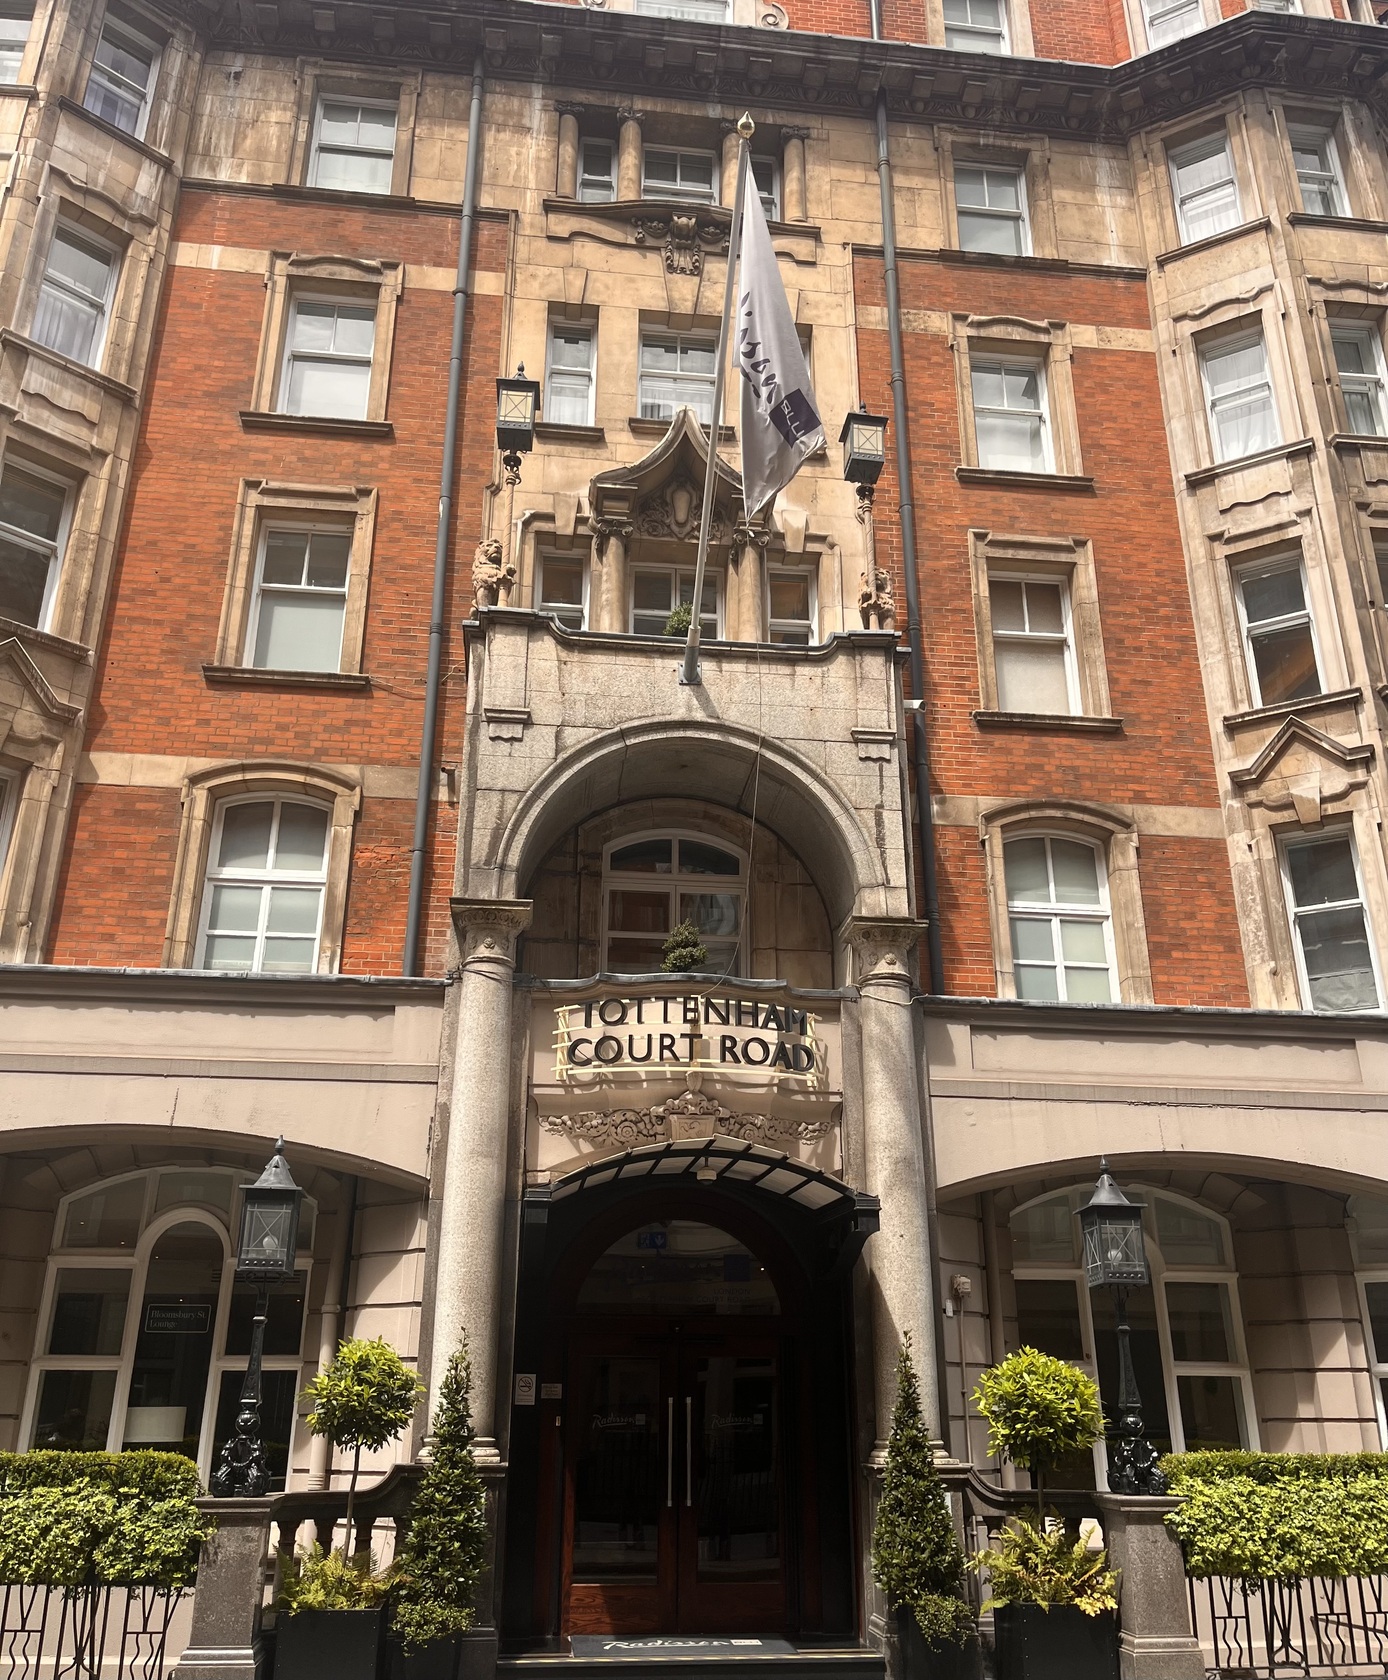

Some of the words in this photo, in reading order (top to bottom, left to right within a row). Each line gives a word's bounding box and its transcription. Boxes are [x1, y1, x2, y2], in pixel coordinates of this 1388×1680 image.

[780, 399, 805, 439] BLU
[580, 996, 807, 1035] TOTTENHAM
[567, 1033, 702, 1066] COURT
[719, 1035, 815, 1072] ROAD
[151, 1310, 196, 1320] Bloomsbury
[150, 1320, 177, 1330] Lounge
[592, 1411, 635, 1430] Radisson
[711, 1412, 753, 1430] Radisson
[601, 1639, 729, 1650] Radisson
